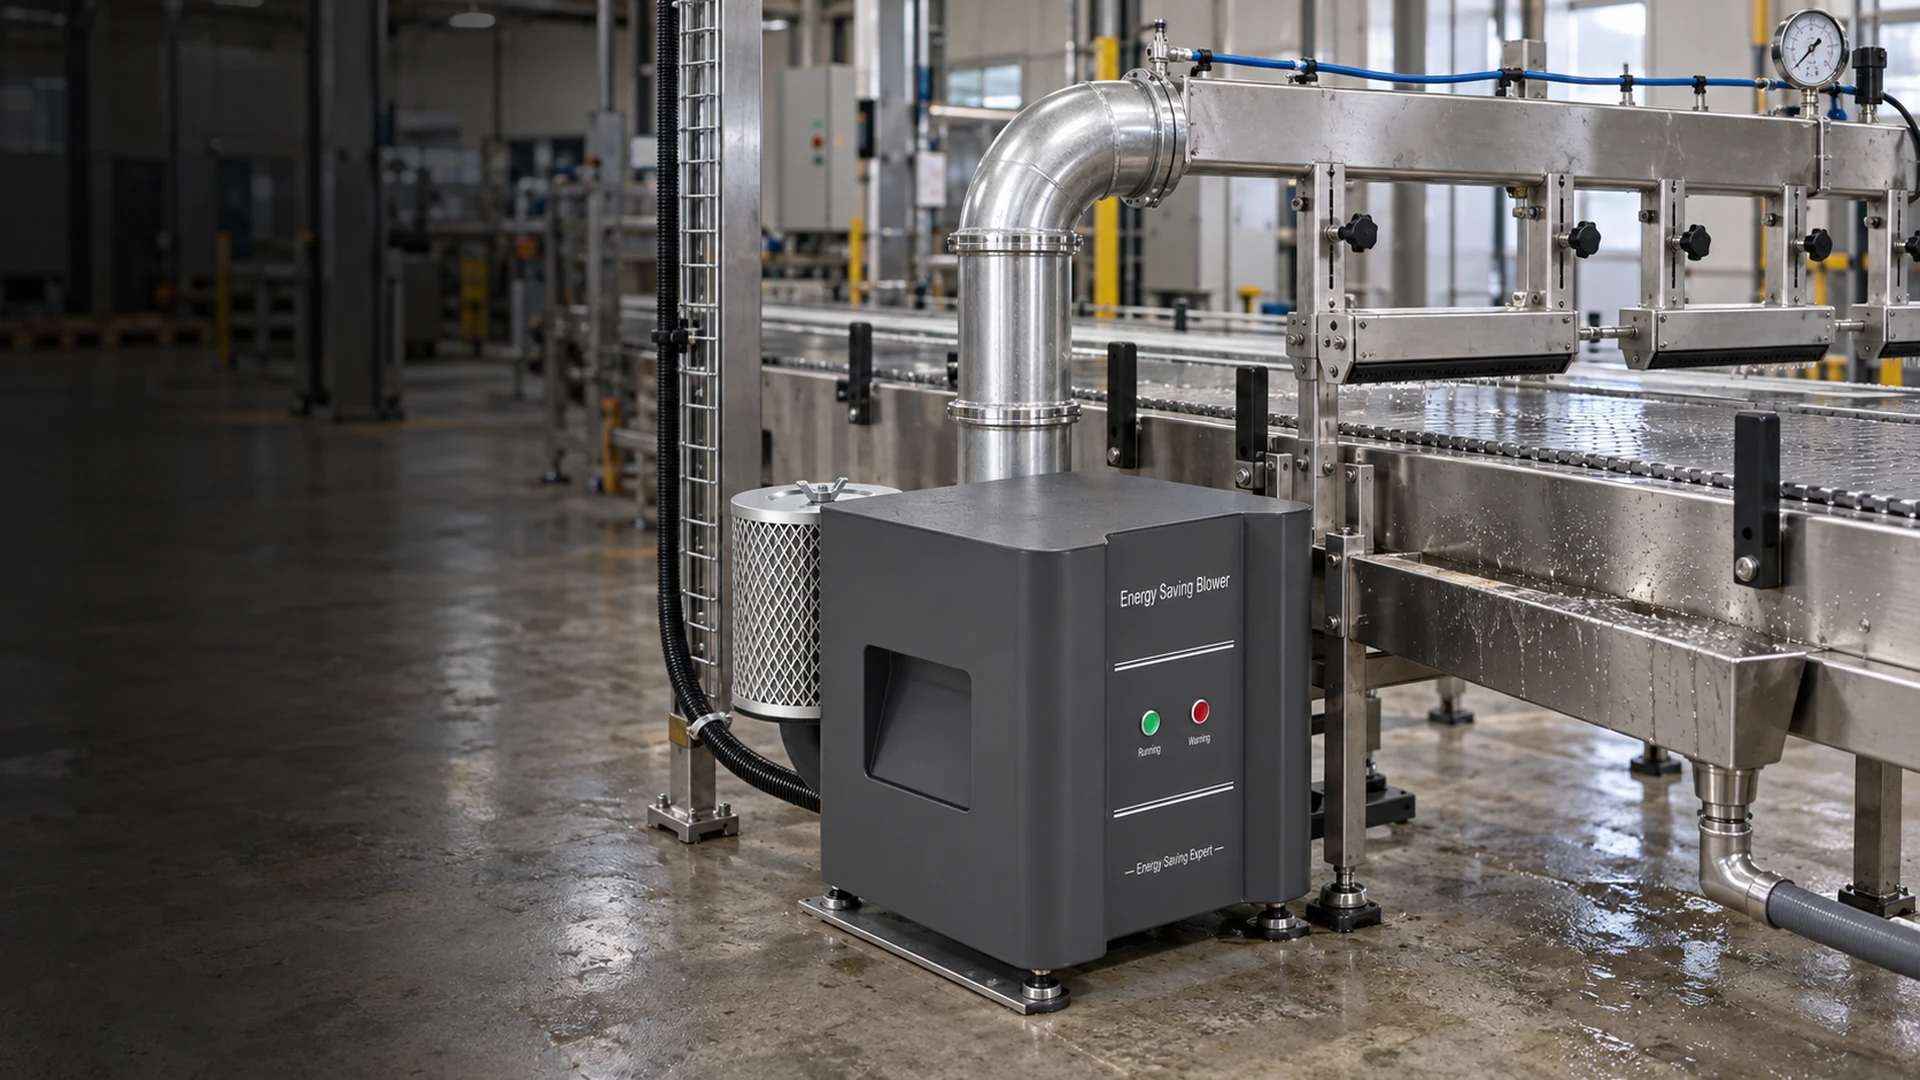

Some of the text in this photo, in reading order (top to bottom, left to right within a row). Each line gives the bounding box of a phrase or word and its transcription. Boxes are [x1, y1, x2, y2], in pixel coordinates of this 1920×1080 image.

[1120, 575, 1231, 607] Energy Saving Blower
[1138, 744, 1162, 757] Running
[1187, 733, 1211, 746] Warning
[1136, 844, 1213, 875] Energy Saving Expert
